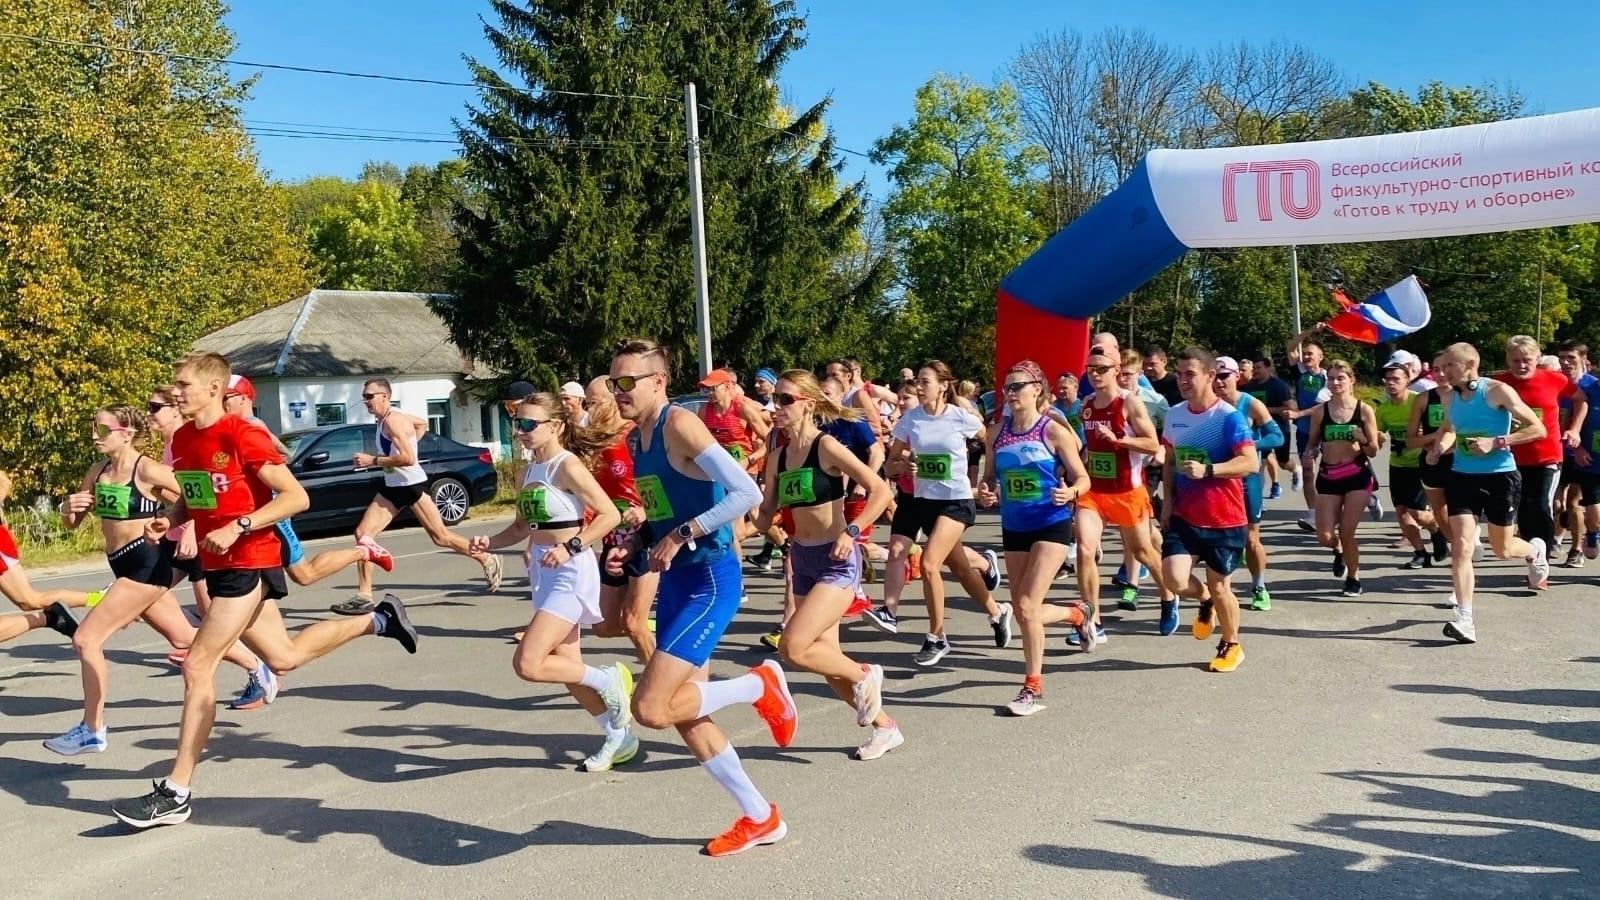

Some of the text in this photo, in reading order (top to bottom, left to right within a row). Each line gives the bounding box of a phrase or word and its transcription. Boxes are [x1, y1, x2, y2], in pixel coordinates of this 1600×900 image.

[1331, 152, 1462, 178] Всероссийский
[1222, 158, 1321, 222] ГТО
[1330, 161, 1574, 201] физкультурно-спортивный
[1333, 188, 1575, 218] «Готов к труду и обороне»
[918, 461, 947, 474] 190
[183, 482, 204, 500] 83
[785, 479, 802, 496] 41
[1006, 478, 1036, 493] 195
